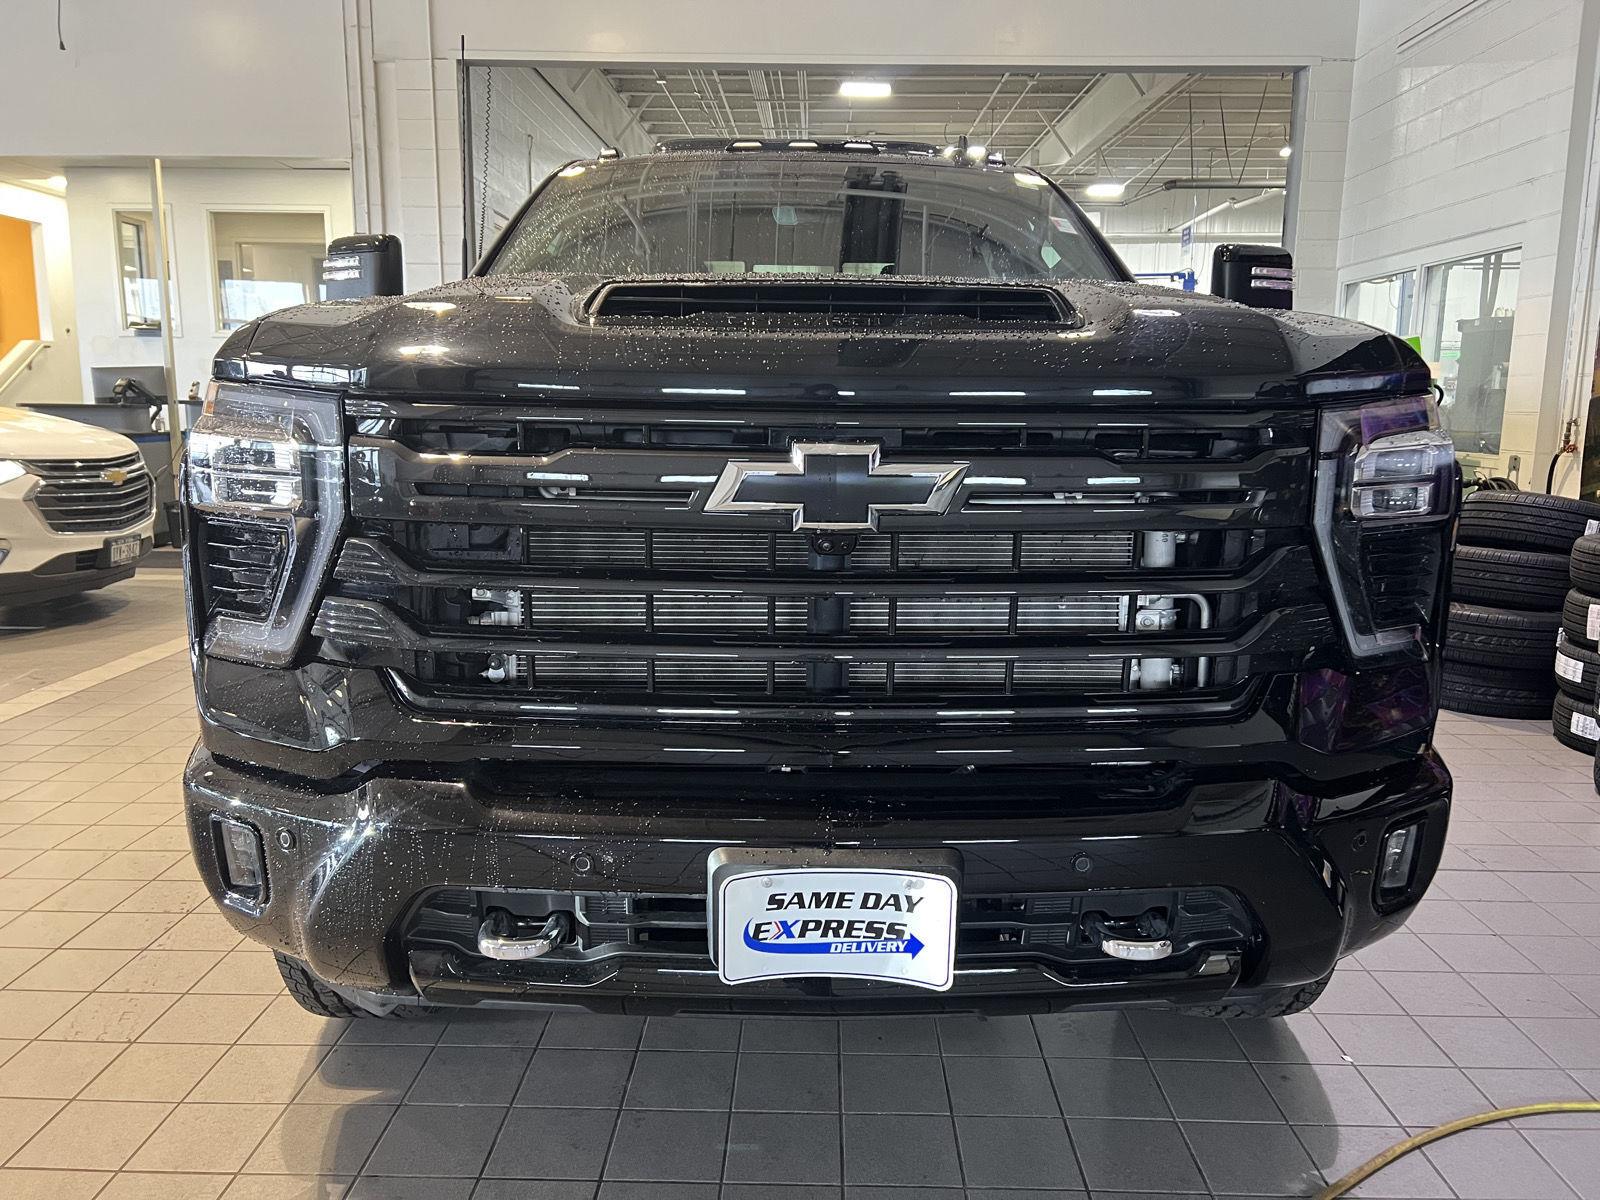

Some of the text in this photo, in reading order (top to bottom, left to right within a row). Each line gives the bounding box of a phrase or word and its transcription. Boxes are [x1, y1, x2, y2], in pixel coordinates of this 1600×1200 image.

[766, 892, 924, 913] SAME DAY
[752, 919, 907, 940] EXPRESS
[830, 941, 908, 953] DELIVERY
